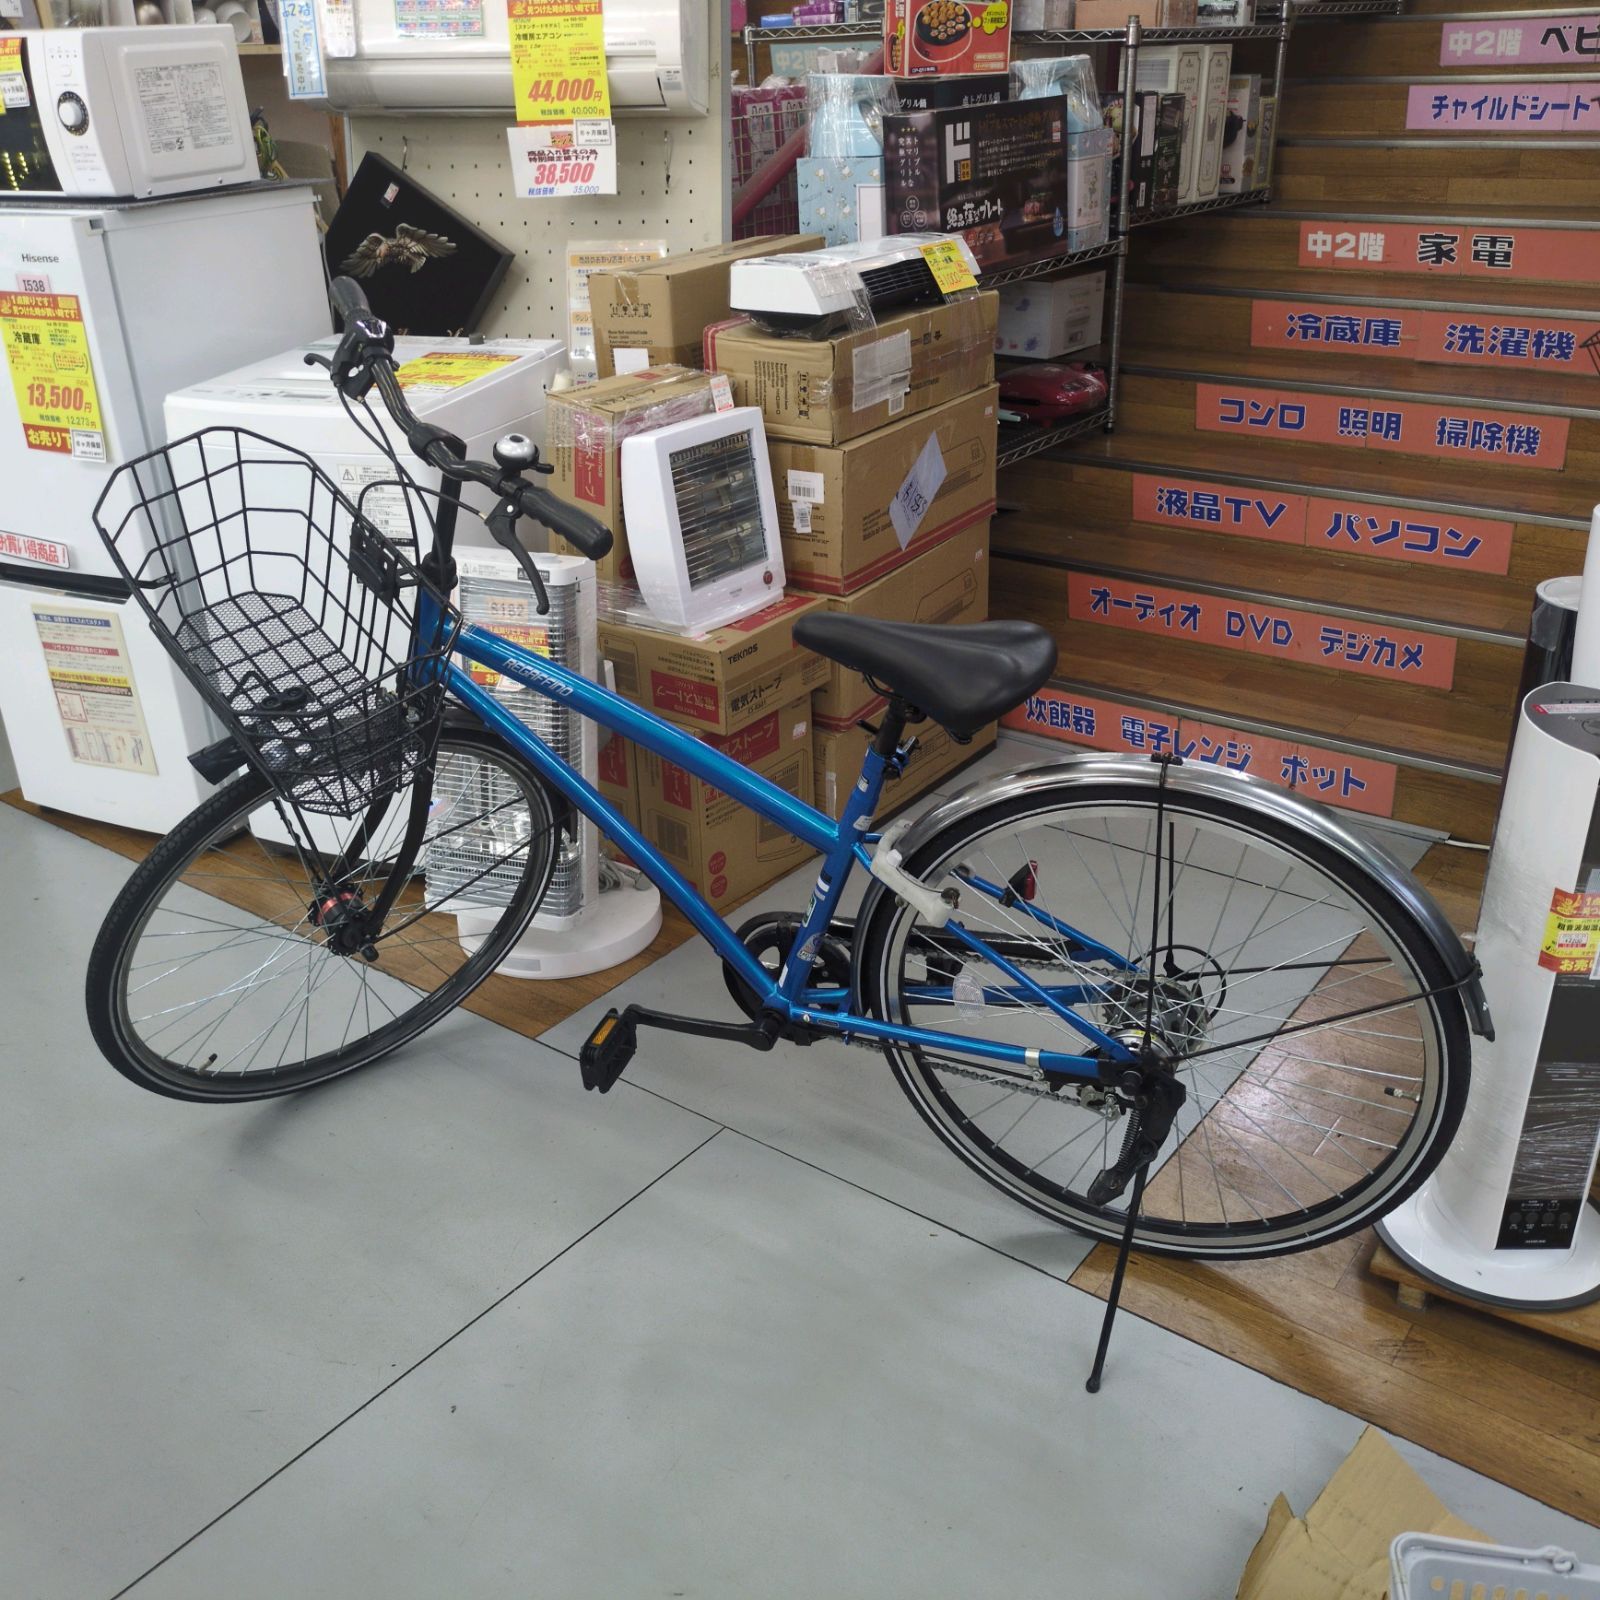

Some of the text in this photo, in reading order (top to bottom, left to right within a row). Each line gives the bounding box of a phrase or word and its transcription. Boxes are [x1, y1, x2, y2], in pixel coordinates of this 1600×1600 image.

[1449, 29, 1522, 57] 中2階
[1431, 94, 1591, 121] チャイルドシート
[534, 162, 595, 185] 38,500
[21, 253, 60, 263] Hisense
[1307, 230, 1385, 262] 中2階
[13, 331, 41, 345] 冷蔵庫
[1286, 312, 1577, 361] 冷蔵庫 洗濯機
[1218, 397, 1541, 456] コンロ 照明 掃除機
[1156, 486, 1482, 558] 液晶TV パソコン
[1089, 587, 1424, 670] オーディオ DVD デジカメ
[1024, 696, 1367, 798] 炊飯器 電子レンジ ポット
